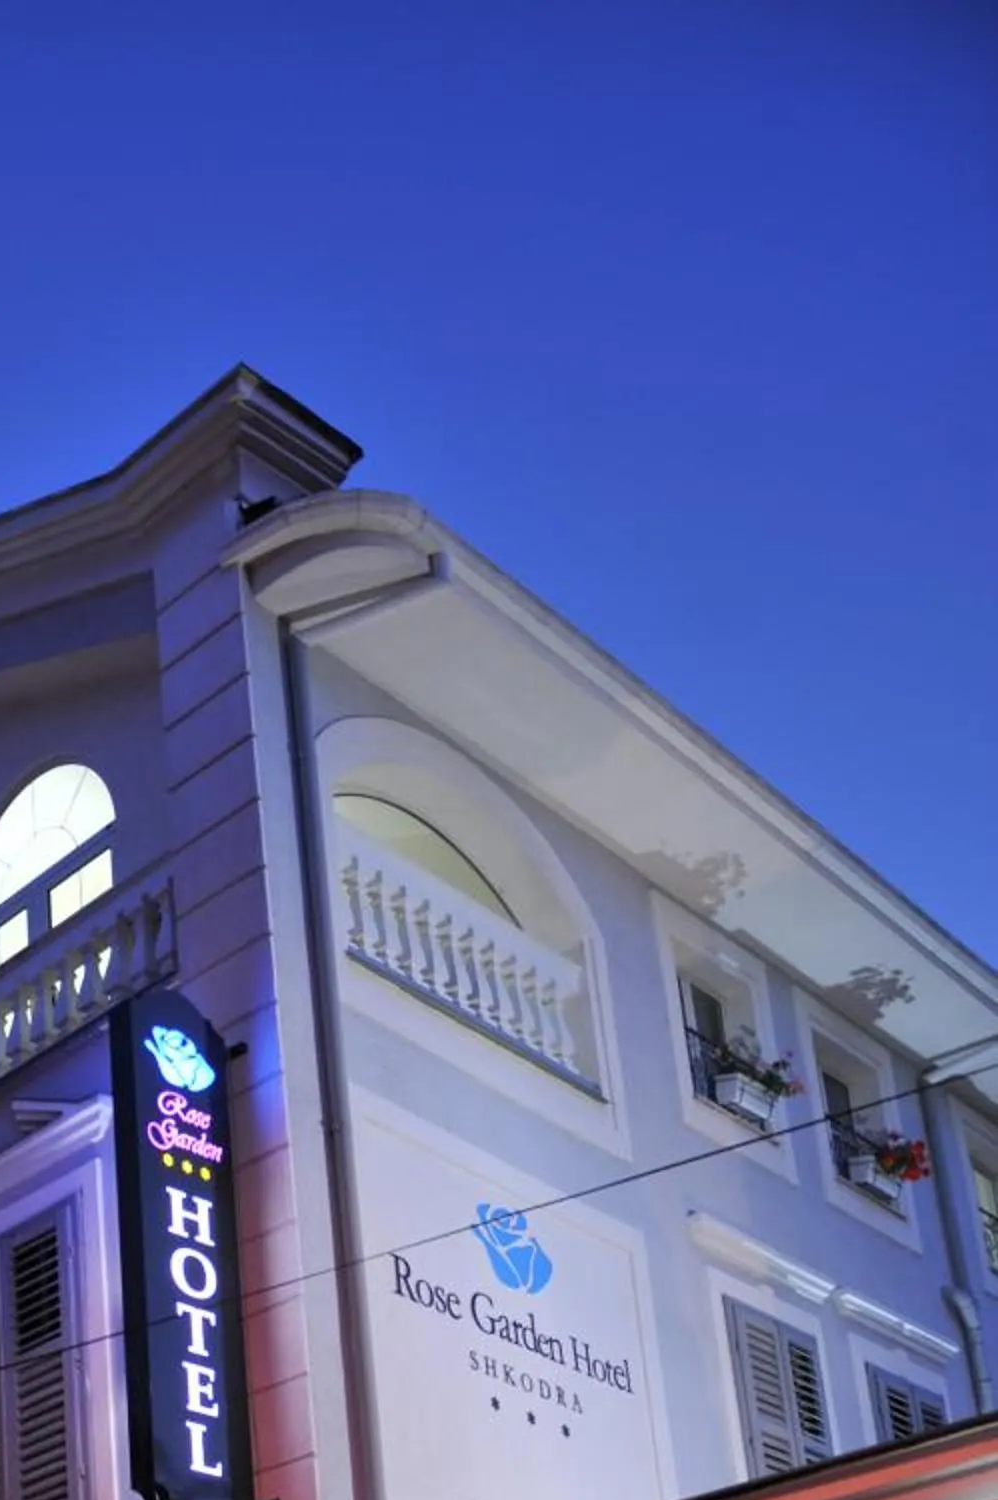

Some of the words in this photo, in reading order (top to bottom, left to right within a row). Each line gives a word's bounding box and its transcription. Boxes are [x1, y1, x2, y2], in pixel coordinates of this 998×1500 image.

[147, 1118, 223, 1163] Garden
[157, 1090, 211, 1130] Rose
[165, 1185, 222, 1478] HOTEL
[389, 1251, 463, 1320] Rose
[470, 1291, 565, 1366] Garden
[569, 1335, 634, 1394] Hotel
[469, 1349, 584, 1415] SHKODRA
